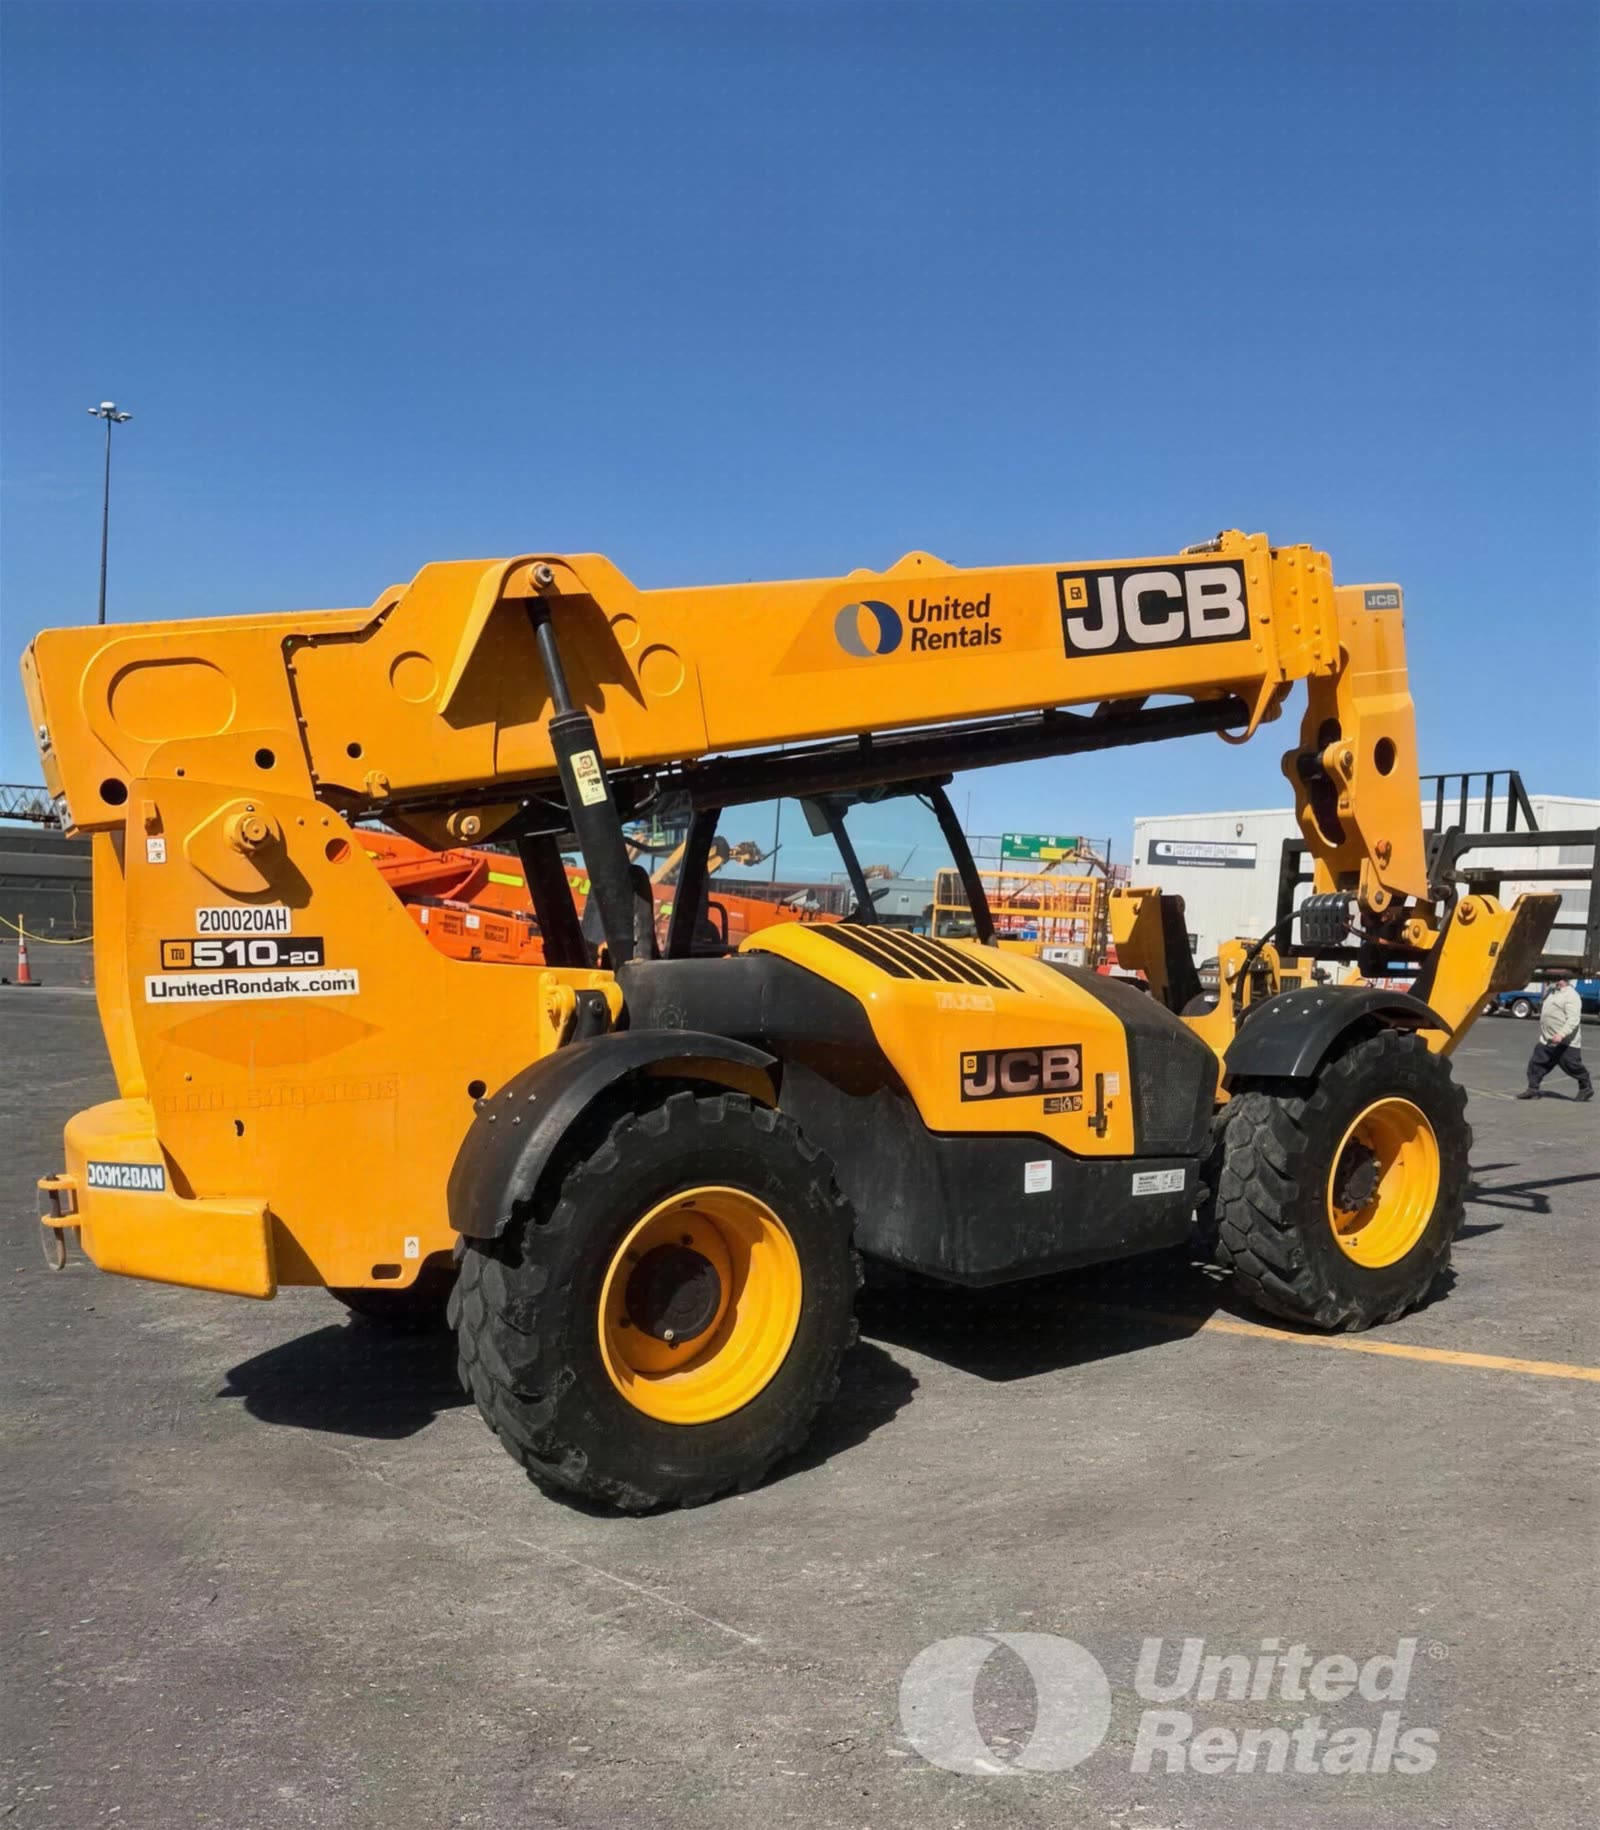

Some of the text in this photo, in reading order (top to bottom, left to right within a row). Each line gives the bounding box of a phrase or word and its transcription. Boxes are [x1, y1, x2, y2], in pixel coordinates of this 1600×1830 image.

[907, 593, 991, 624] United
[1067, 567, 1246, 650] JCB
[1367, 594, 1398, 606] JCB
[911, 621, 1002, 652] Rentals
[199, 908, 287, 932] 200020AH
[963, 1048, 1080, 1097] JCB
